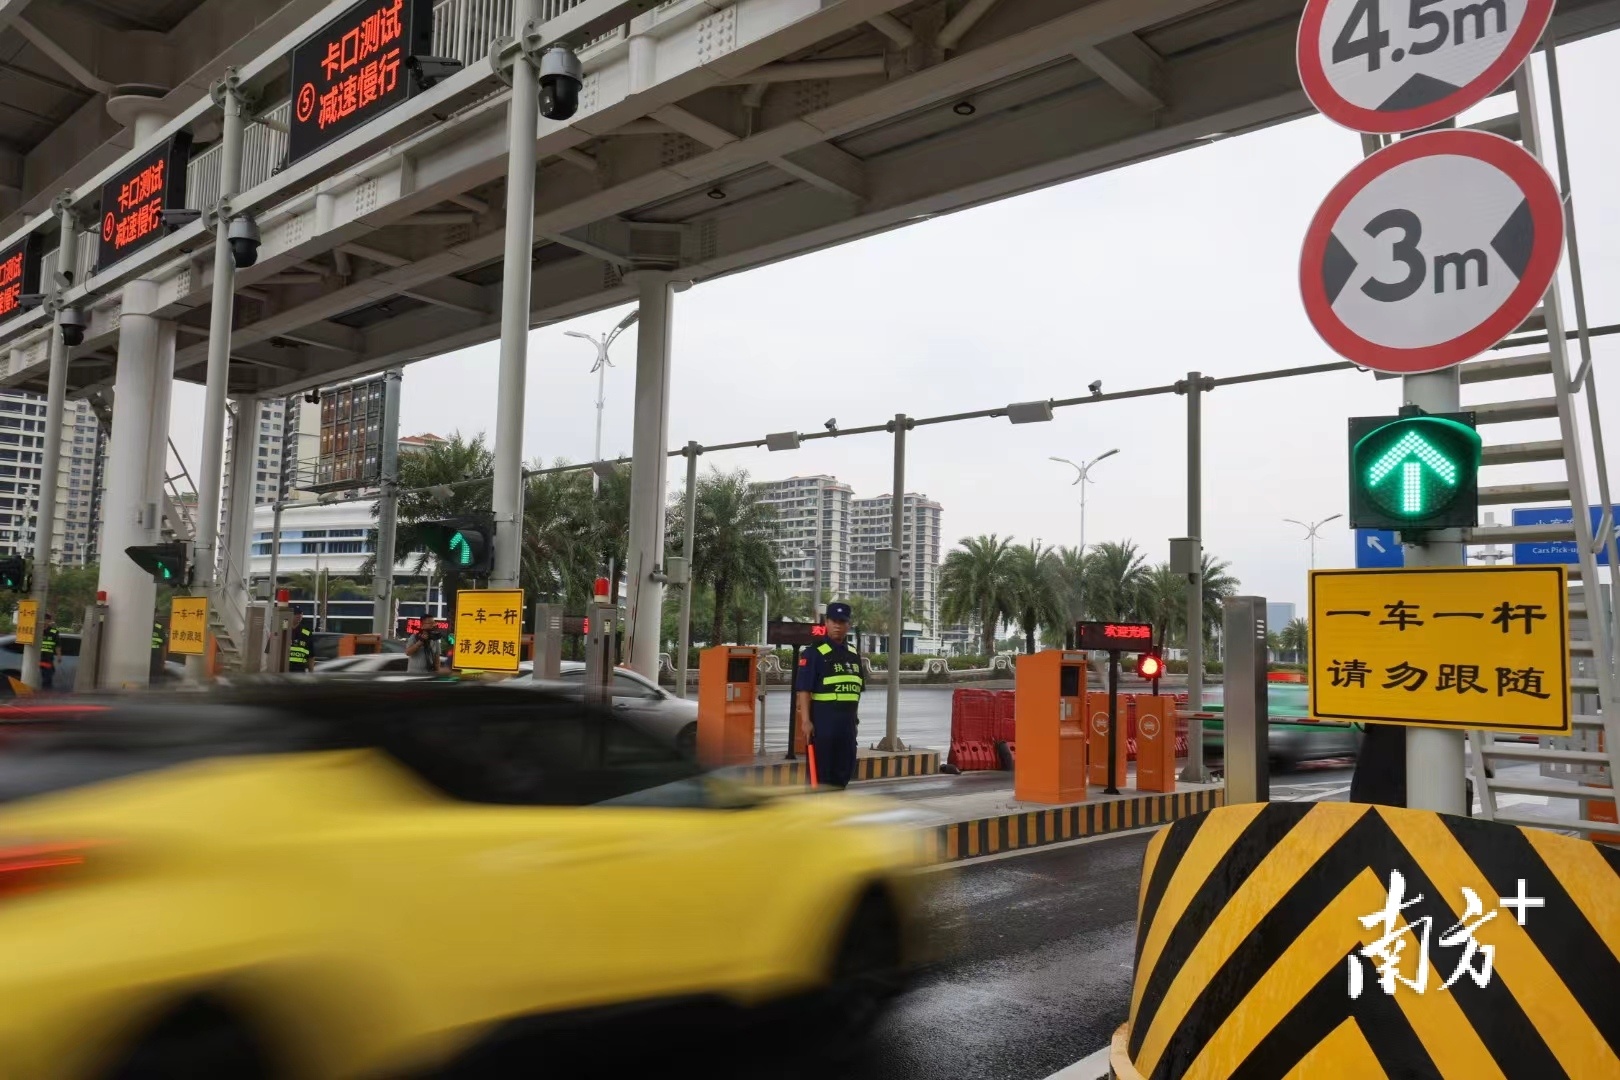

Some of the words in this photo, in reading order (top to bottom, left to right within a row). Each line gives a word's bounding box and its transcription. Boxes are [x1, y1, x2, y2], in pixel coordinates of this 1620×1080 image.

[321, 0, 403, 81] 卡口测试
[1332, 0, 1507, 73] 4.5m
[319, 47, 400, 130] 减速慢行
[118, 159, 164, 213] 卡口测试
[115, 197, 162, 250] 减速慢行
[1360, 208, 1488, 303] 3m
[1551, 546, 1579, 554] Pick-u
[461, 608, 517, 625] 一车一杆
[1326, 600, 1547, 635] 一车一杆
[460, 639, 516, 657] 请勿跟随
[1326, 659, 1551, 699] 请勿跟随
